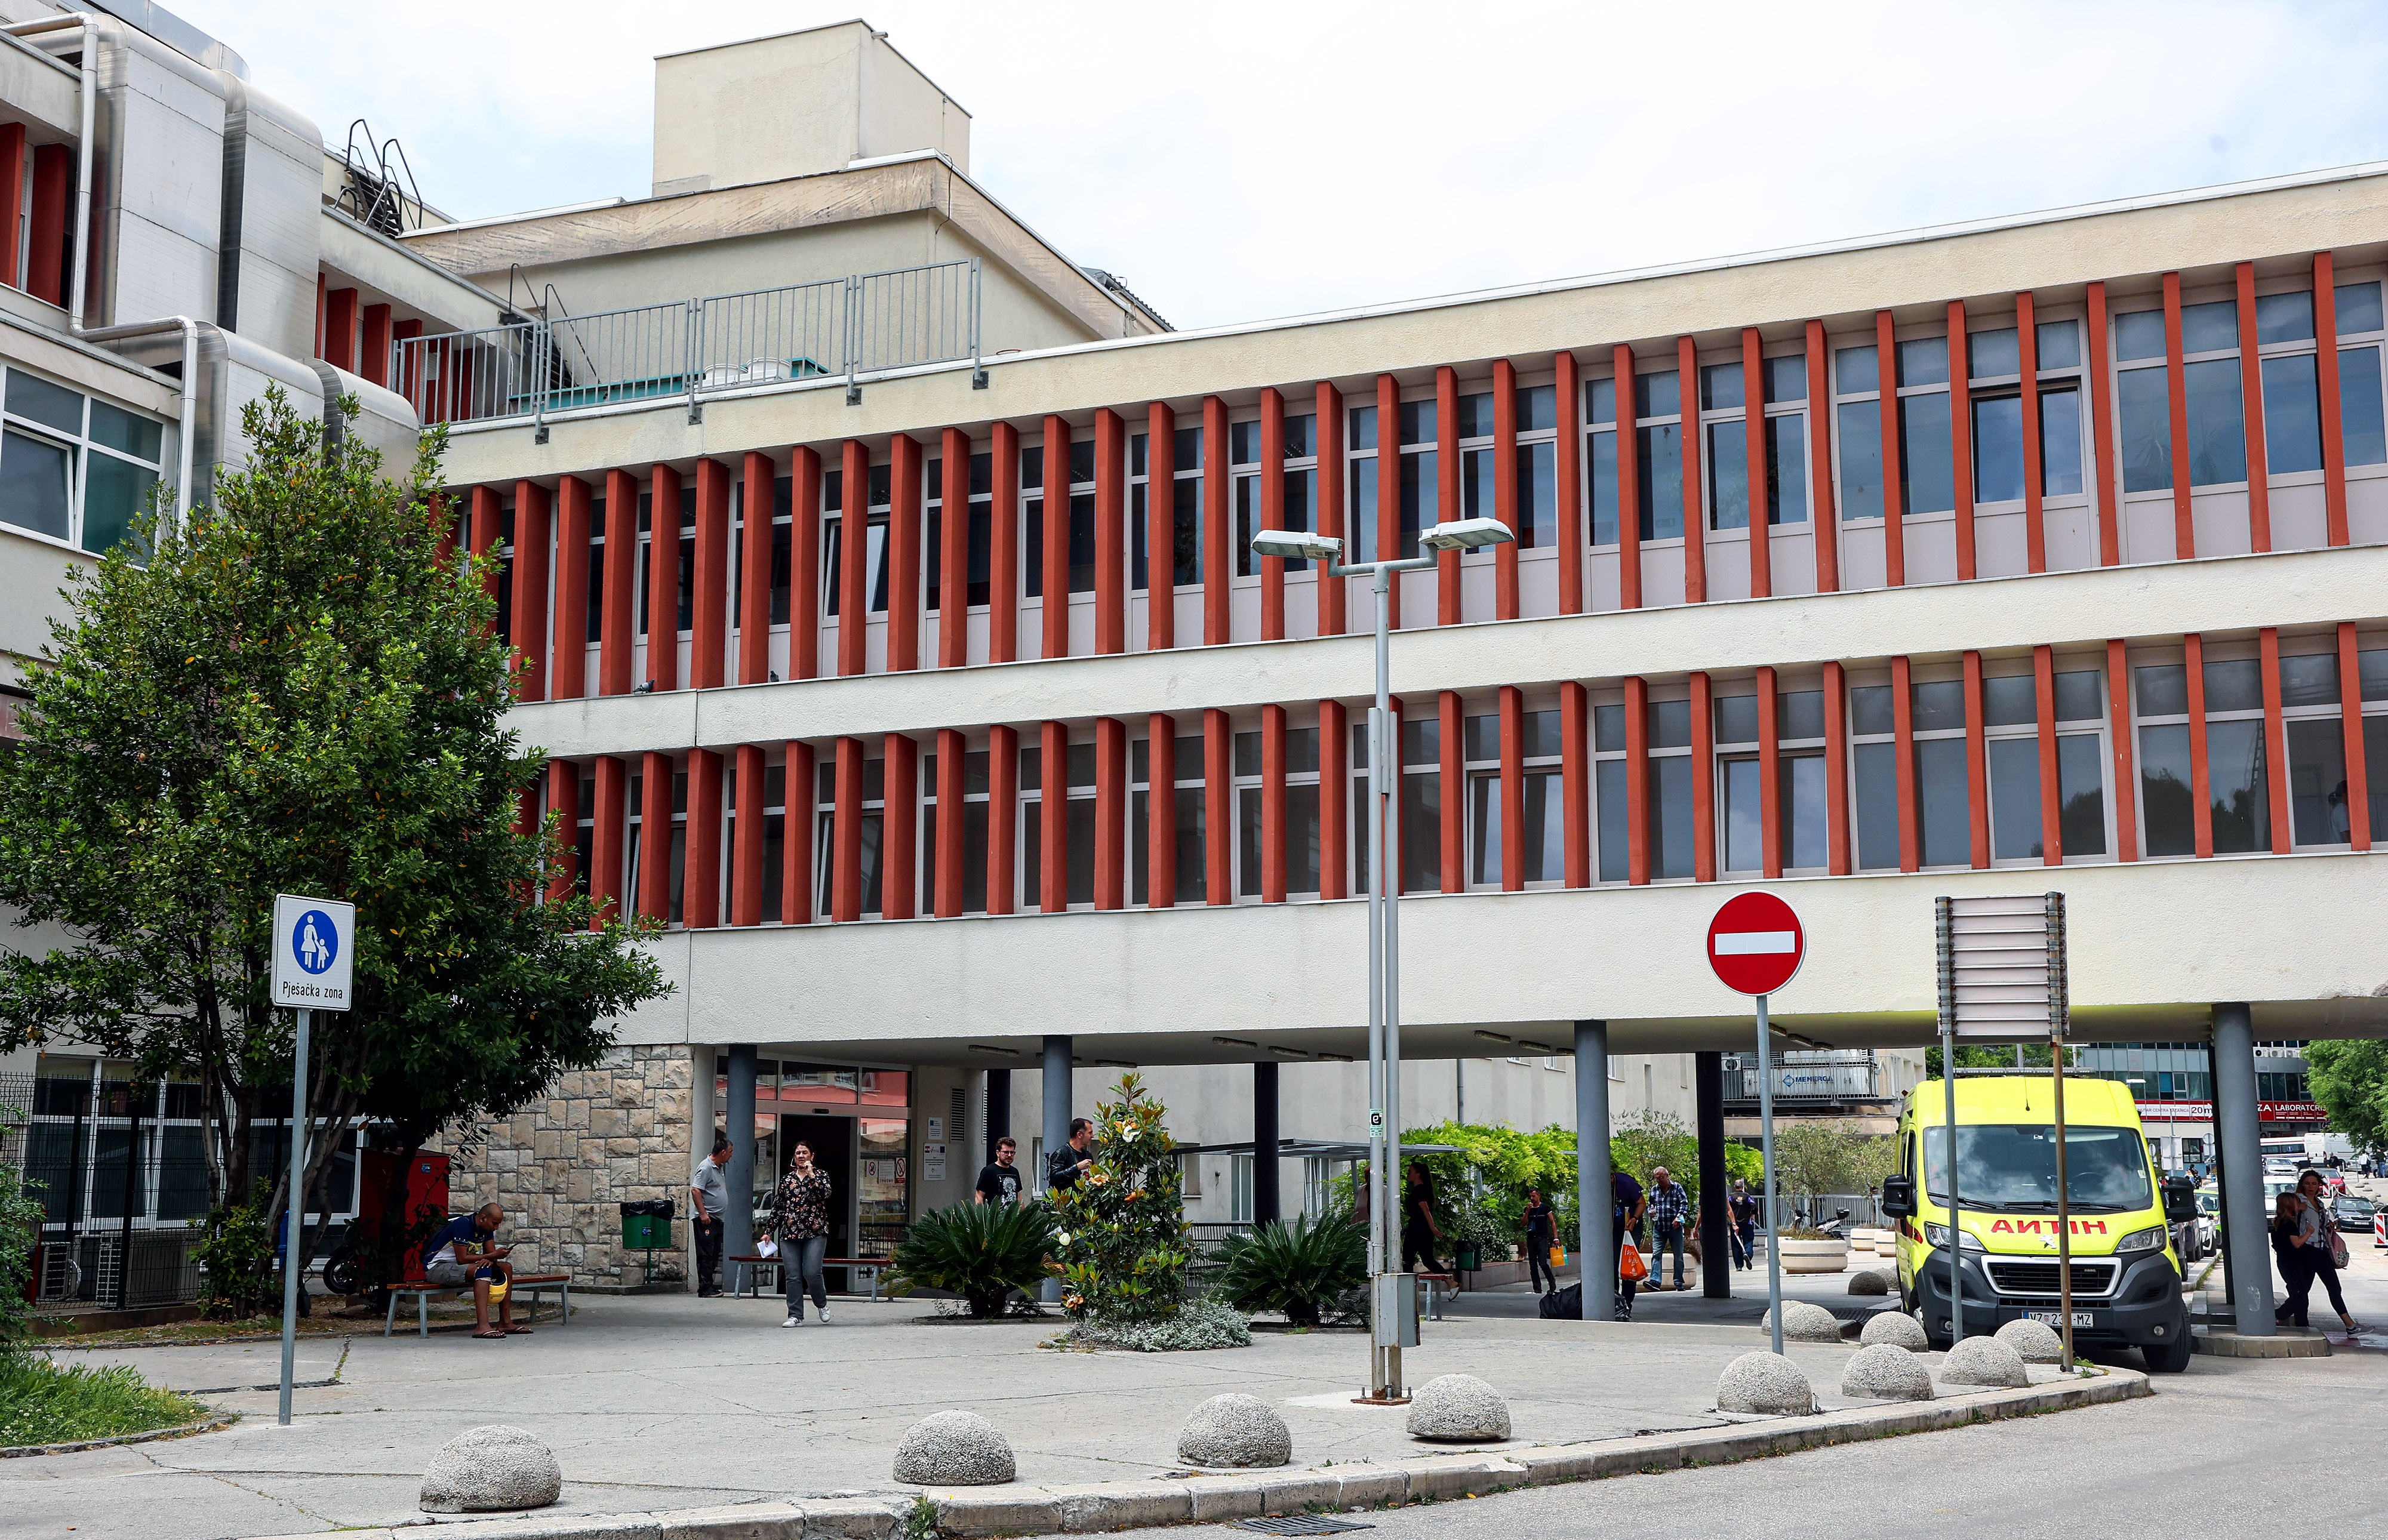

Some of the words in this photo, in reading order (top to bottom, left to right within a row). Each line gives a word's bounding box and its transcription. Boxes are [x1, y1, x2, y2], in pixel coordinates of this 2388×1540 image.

[283, 981, 320, 998] Pješačka
[324, 988, 343, 999] zona
[2051, 1313, 2091, 1325] 23-MZ
